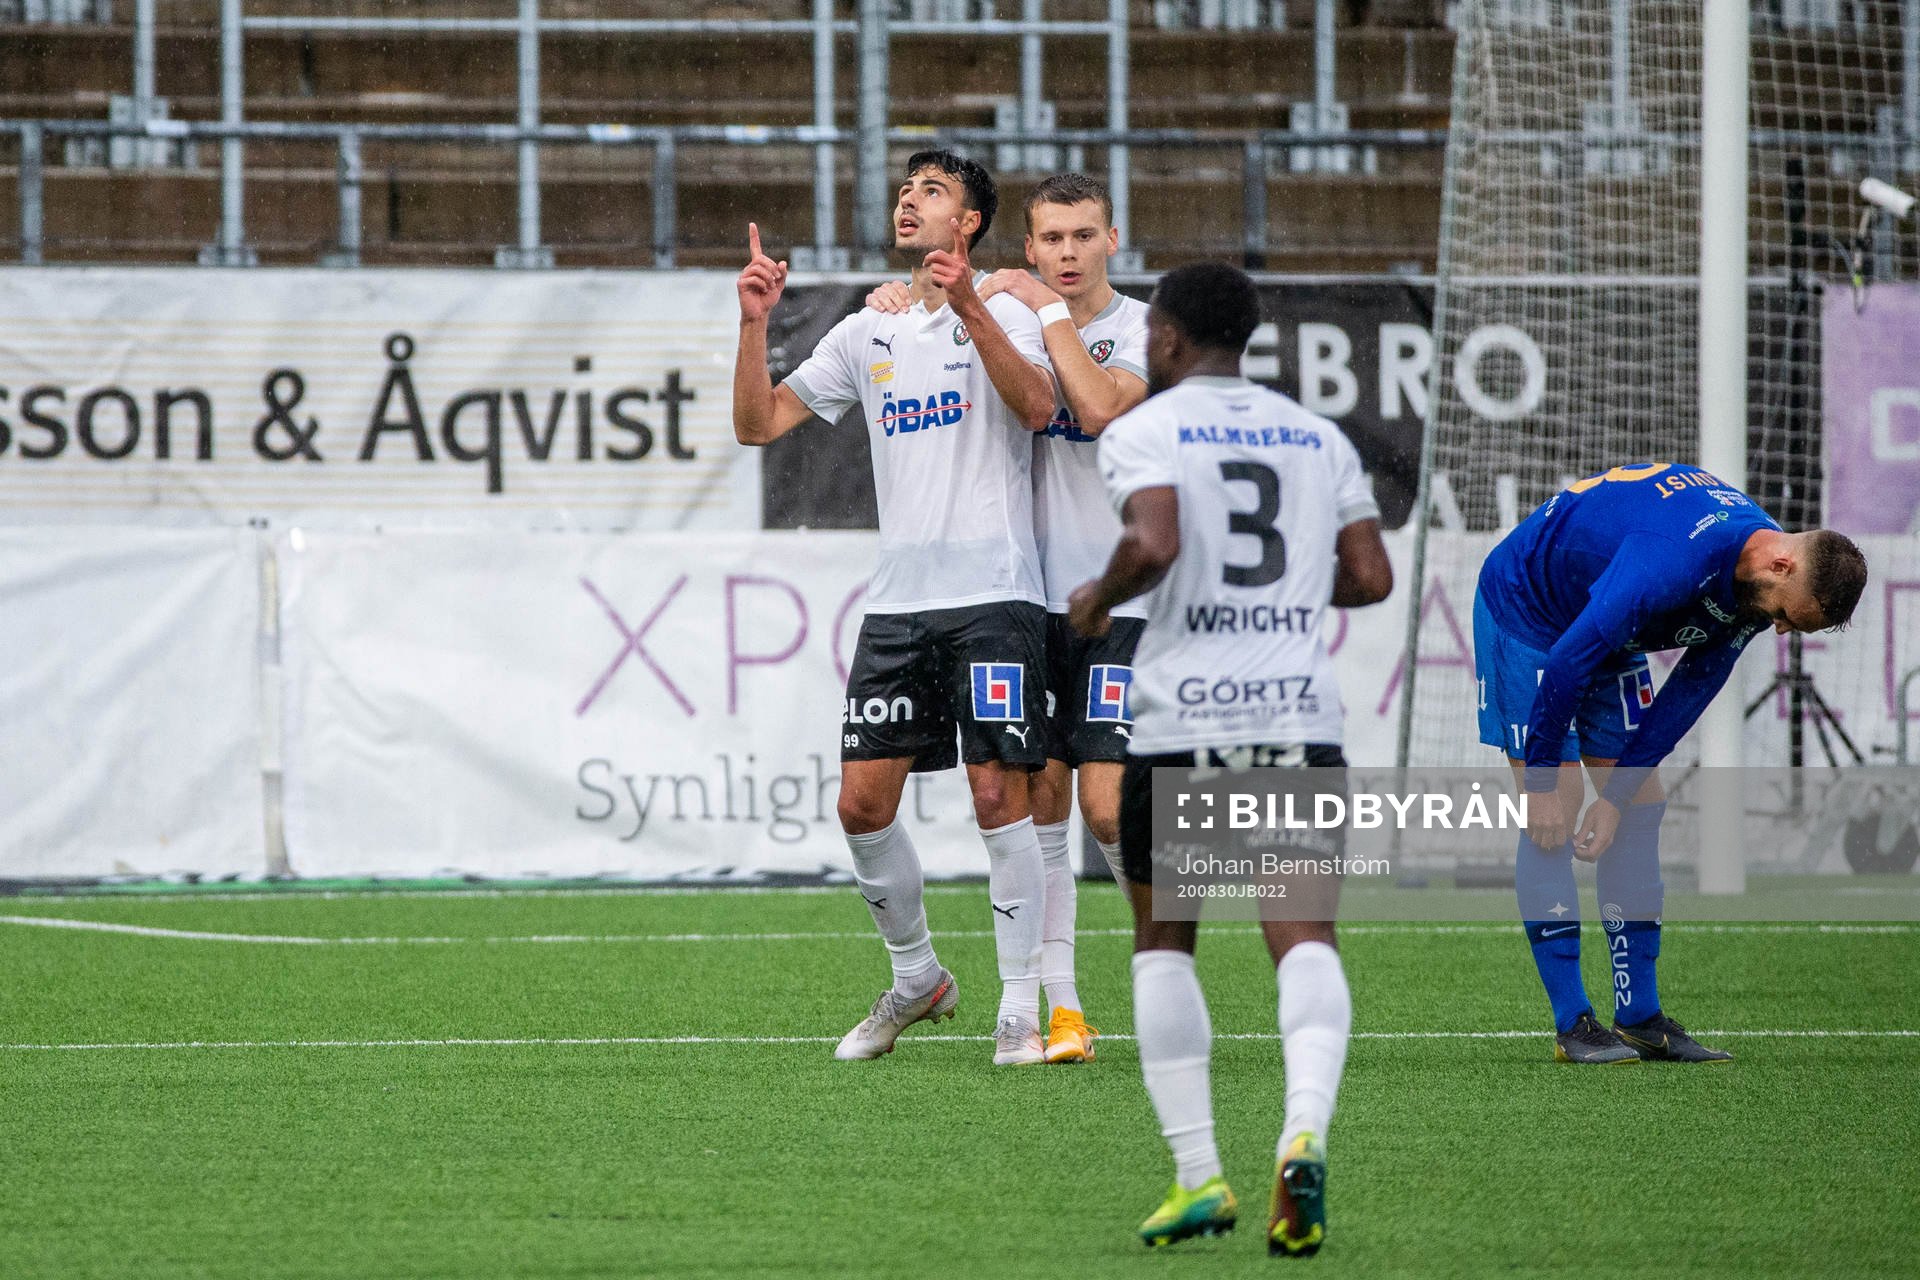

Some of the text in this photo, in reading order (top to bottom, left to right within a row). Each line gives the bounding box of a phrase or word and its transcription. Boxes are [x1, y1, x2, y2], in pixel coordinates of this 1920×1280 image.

[0, 332, 696, 494] son & Åqvist
[882, 391, 963, 436] ÖBAB
[1178, 426, 1322, 449] MALMBERGS
[1655, 472, 1730, 499] QVIST
[1218, 460, 1287, 588] 3
[1186, 604, 1314, 634] WRIGHT
[1177, 675, 1317, 705] GÖRTZ
[844, 733, 859, 748] 99
[575, 754, 938, 844] Synlight
[1608, 934, 1632, 1011] suez
